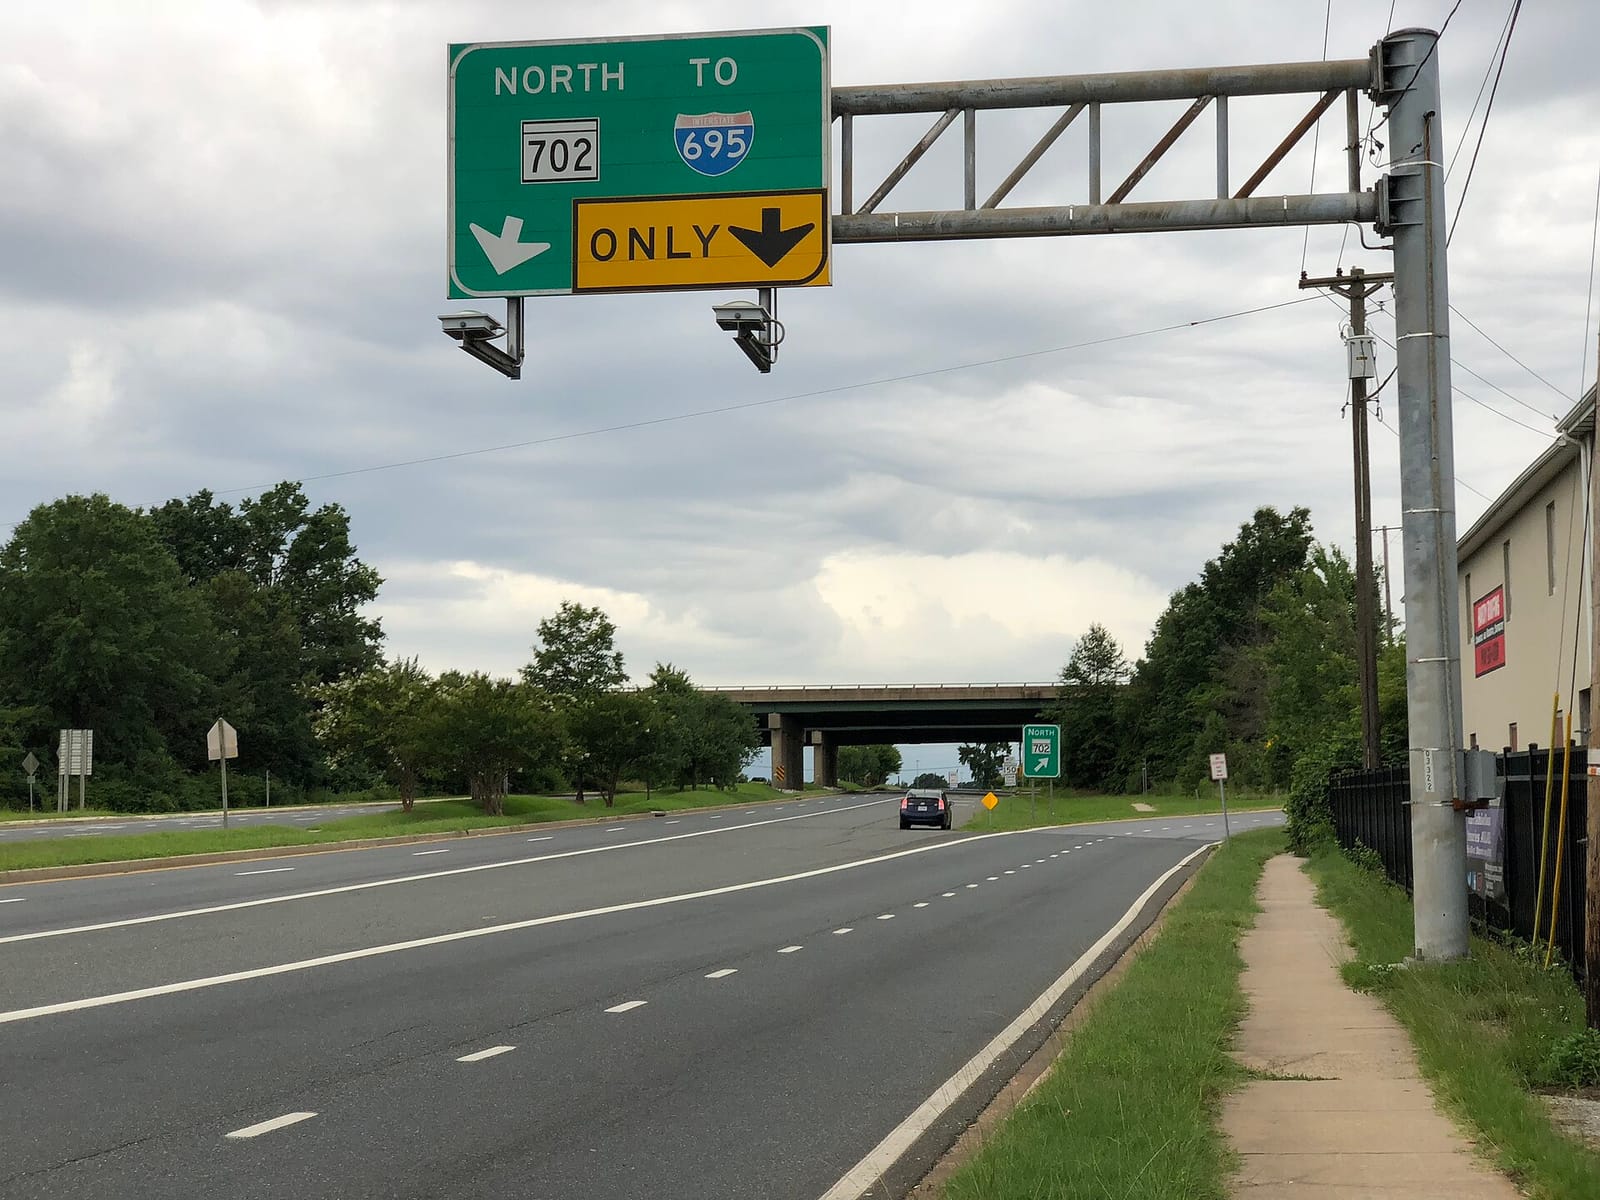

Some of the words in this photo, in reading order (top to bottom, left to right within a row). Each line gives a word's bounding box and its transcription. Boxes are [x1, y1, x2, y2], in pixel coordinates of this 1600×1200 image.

[495, 62, 624, 96] NORTH
[689, 57, 738, 87] TO
[692, 116, 736, 127] INTERSTATE
[528, 137, 592, 173] 702
[683, 129, 746, 160] 695
[590, 225, 720, 262] ONLY
[1033, 743, 1050, 753] 702
